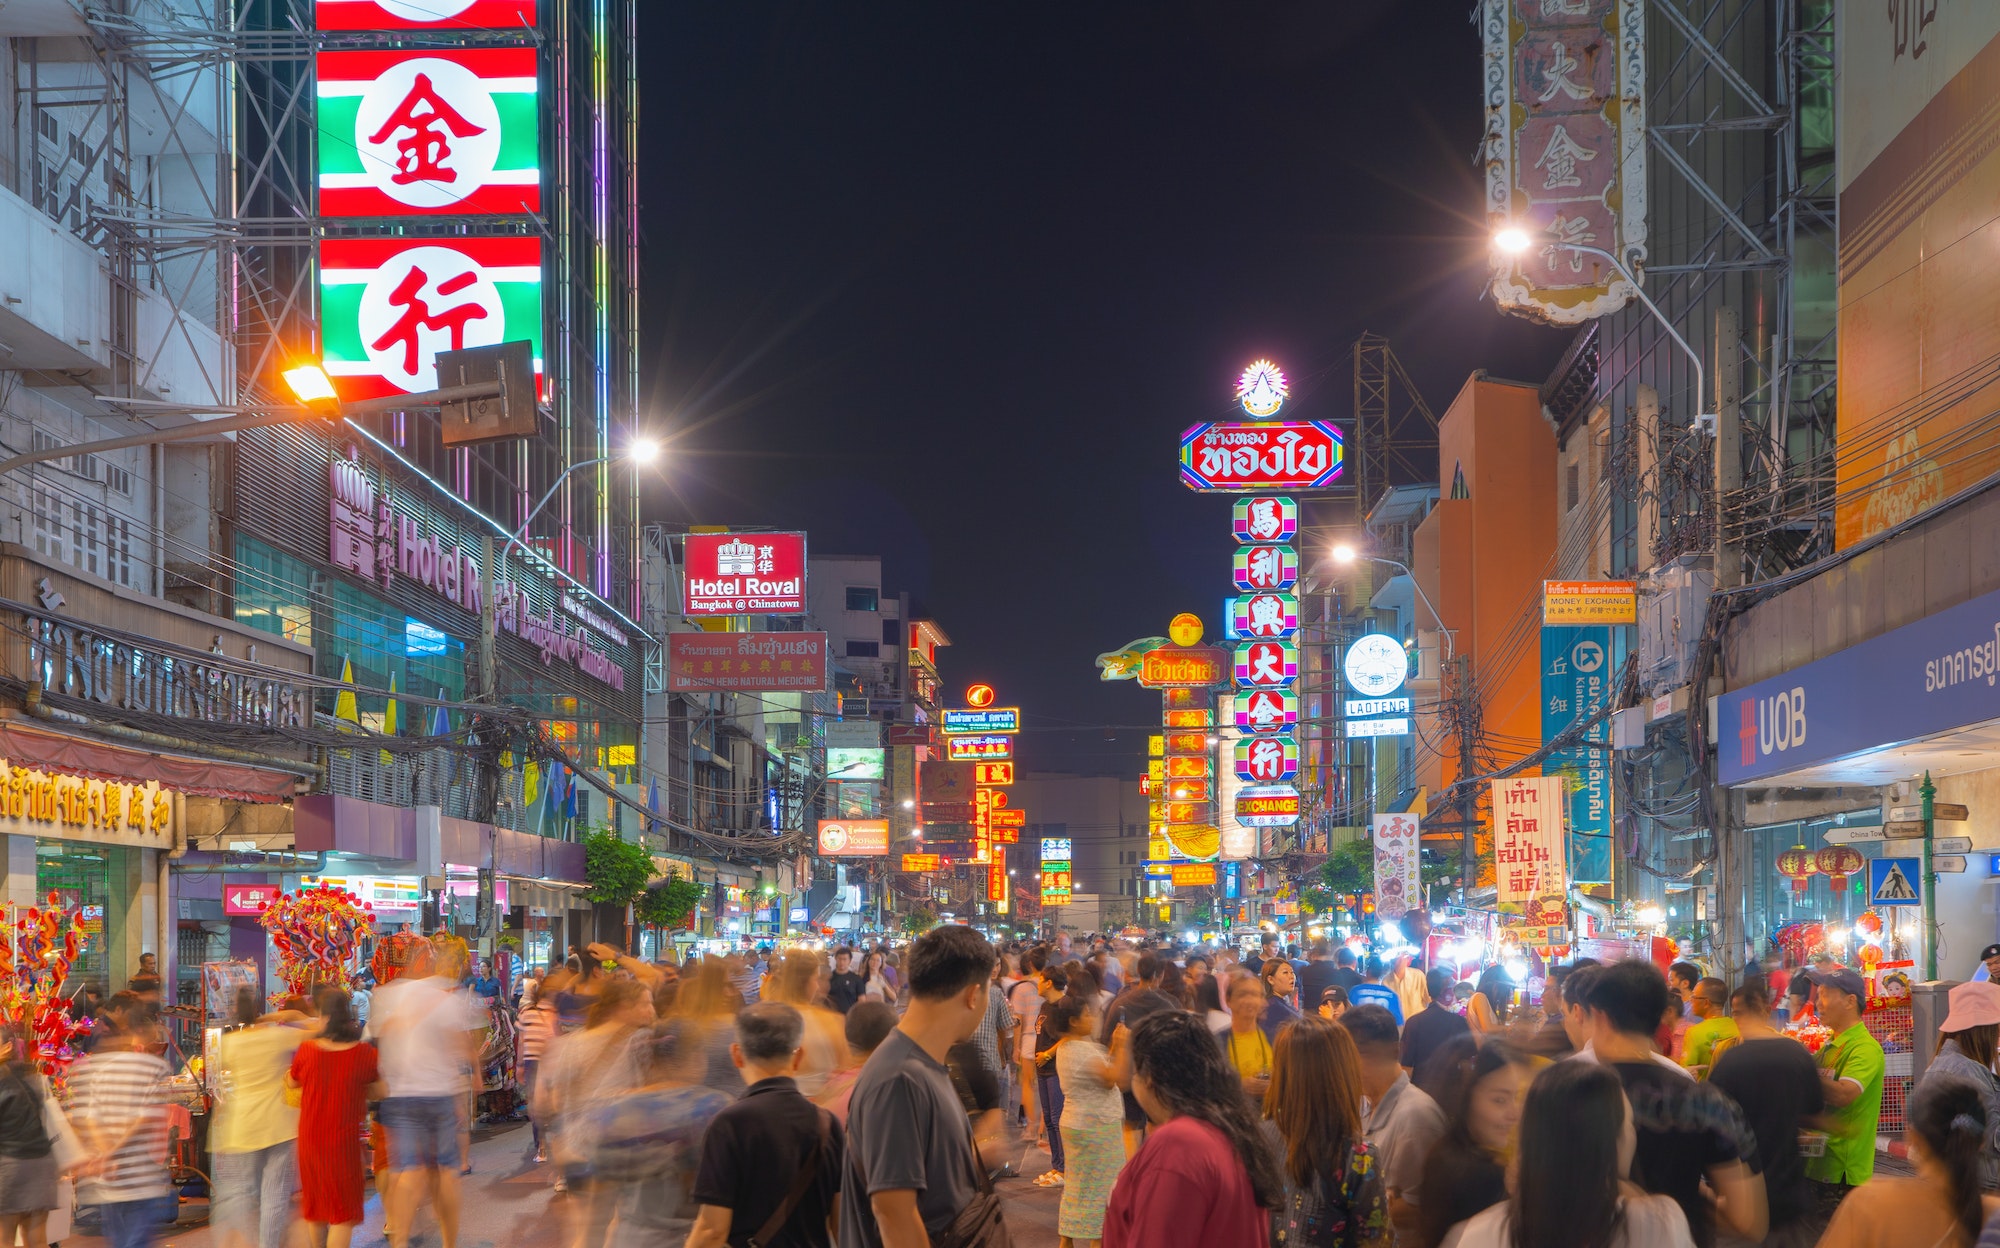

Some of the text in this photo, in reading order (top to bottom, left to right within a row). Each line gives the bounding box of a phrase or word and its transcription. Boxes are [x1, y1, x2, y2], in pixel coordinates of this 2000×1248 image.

[368, 72, 488, 376] 金行
[398, 512, 461, 604] Hotel
[757, 545, 775, 575] 京华
[690, 578, 800, 596] Hotel Royal
[691, 599, 800, 611] Bangkok @ Chinatown
[676, 675, 817, 687] LIM SOON HENG NATURAL MEDICINE
[1351, 701, 1405, 713] LAOTENG
[1760, 685, 1807, 756] UOB
[1237, 799, 1298, 813] EXCHANGE
